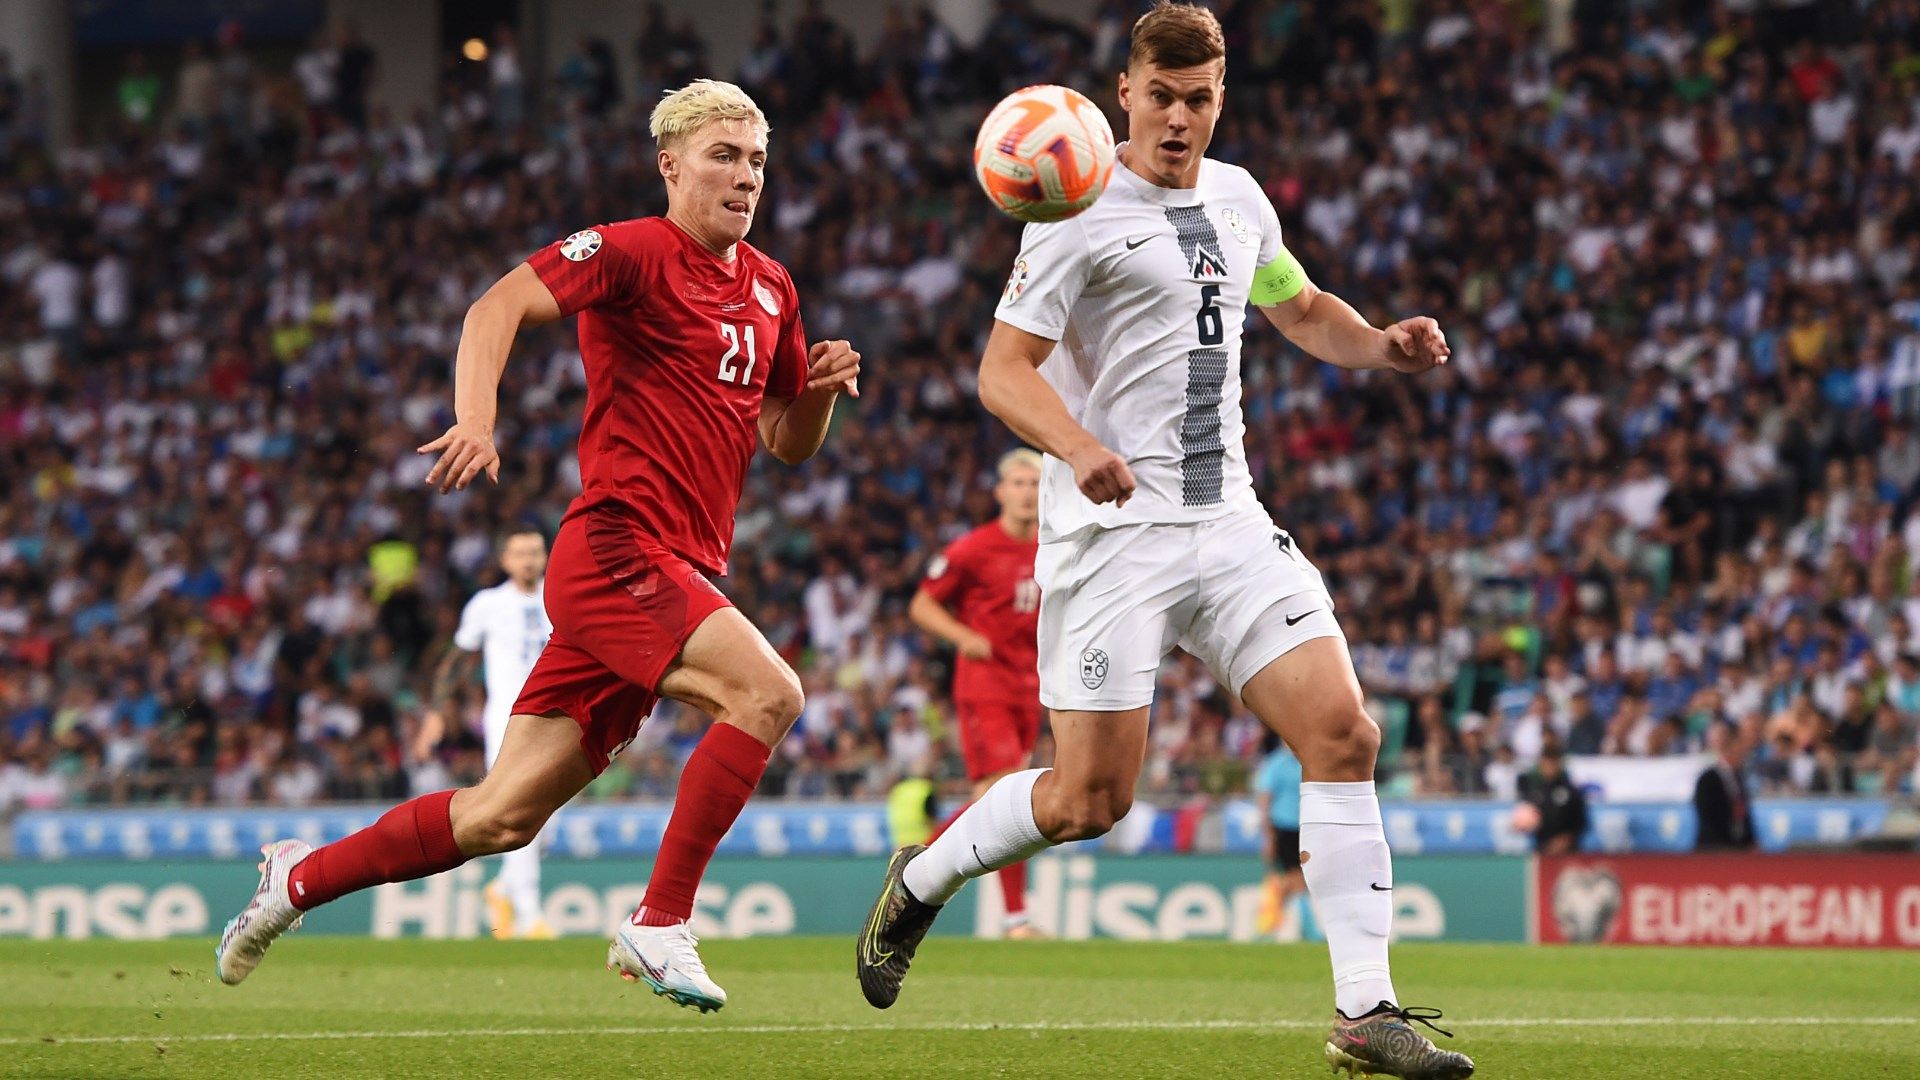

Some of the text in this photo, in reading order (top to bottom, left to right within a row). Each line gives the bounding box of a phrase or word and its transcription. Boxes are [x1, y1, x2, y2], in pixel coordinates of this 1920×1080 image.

[1197, 284, 1223, 345] 6
[718, 322, 756, 386] 21
[1631, 884, 1883, 942] EUROPEAN
